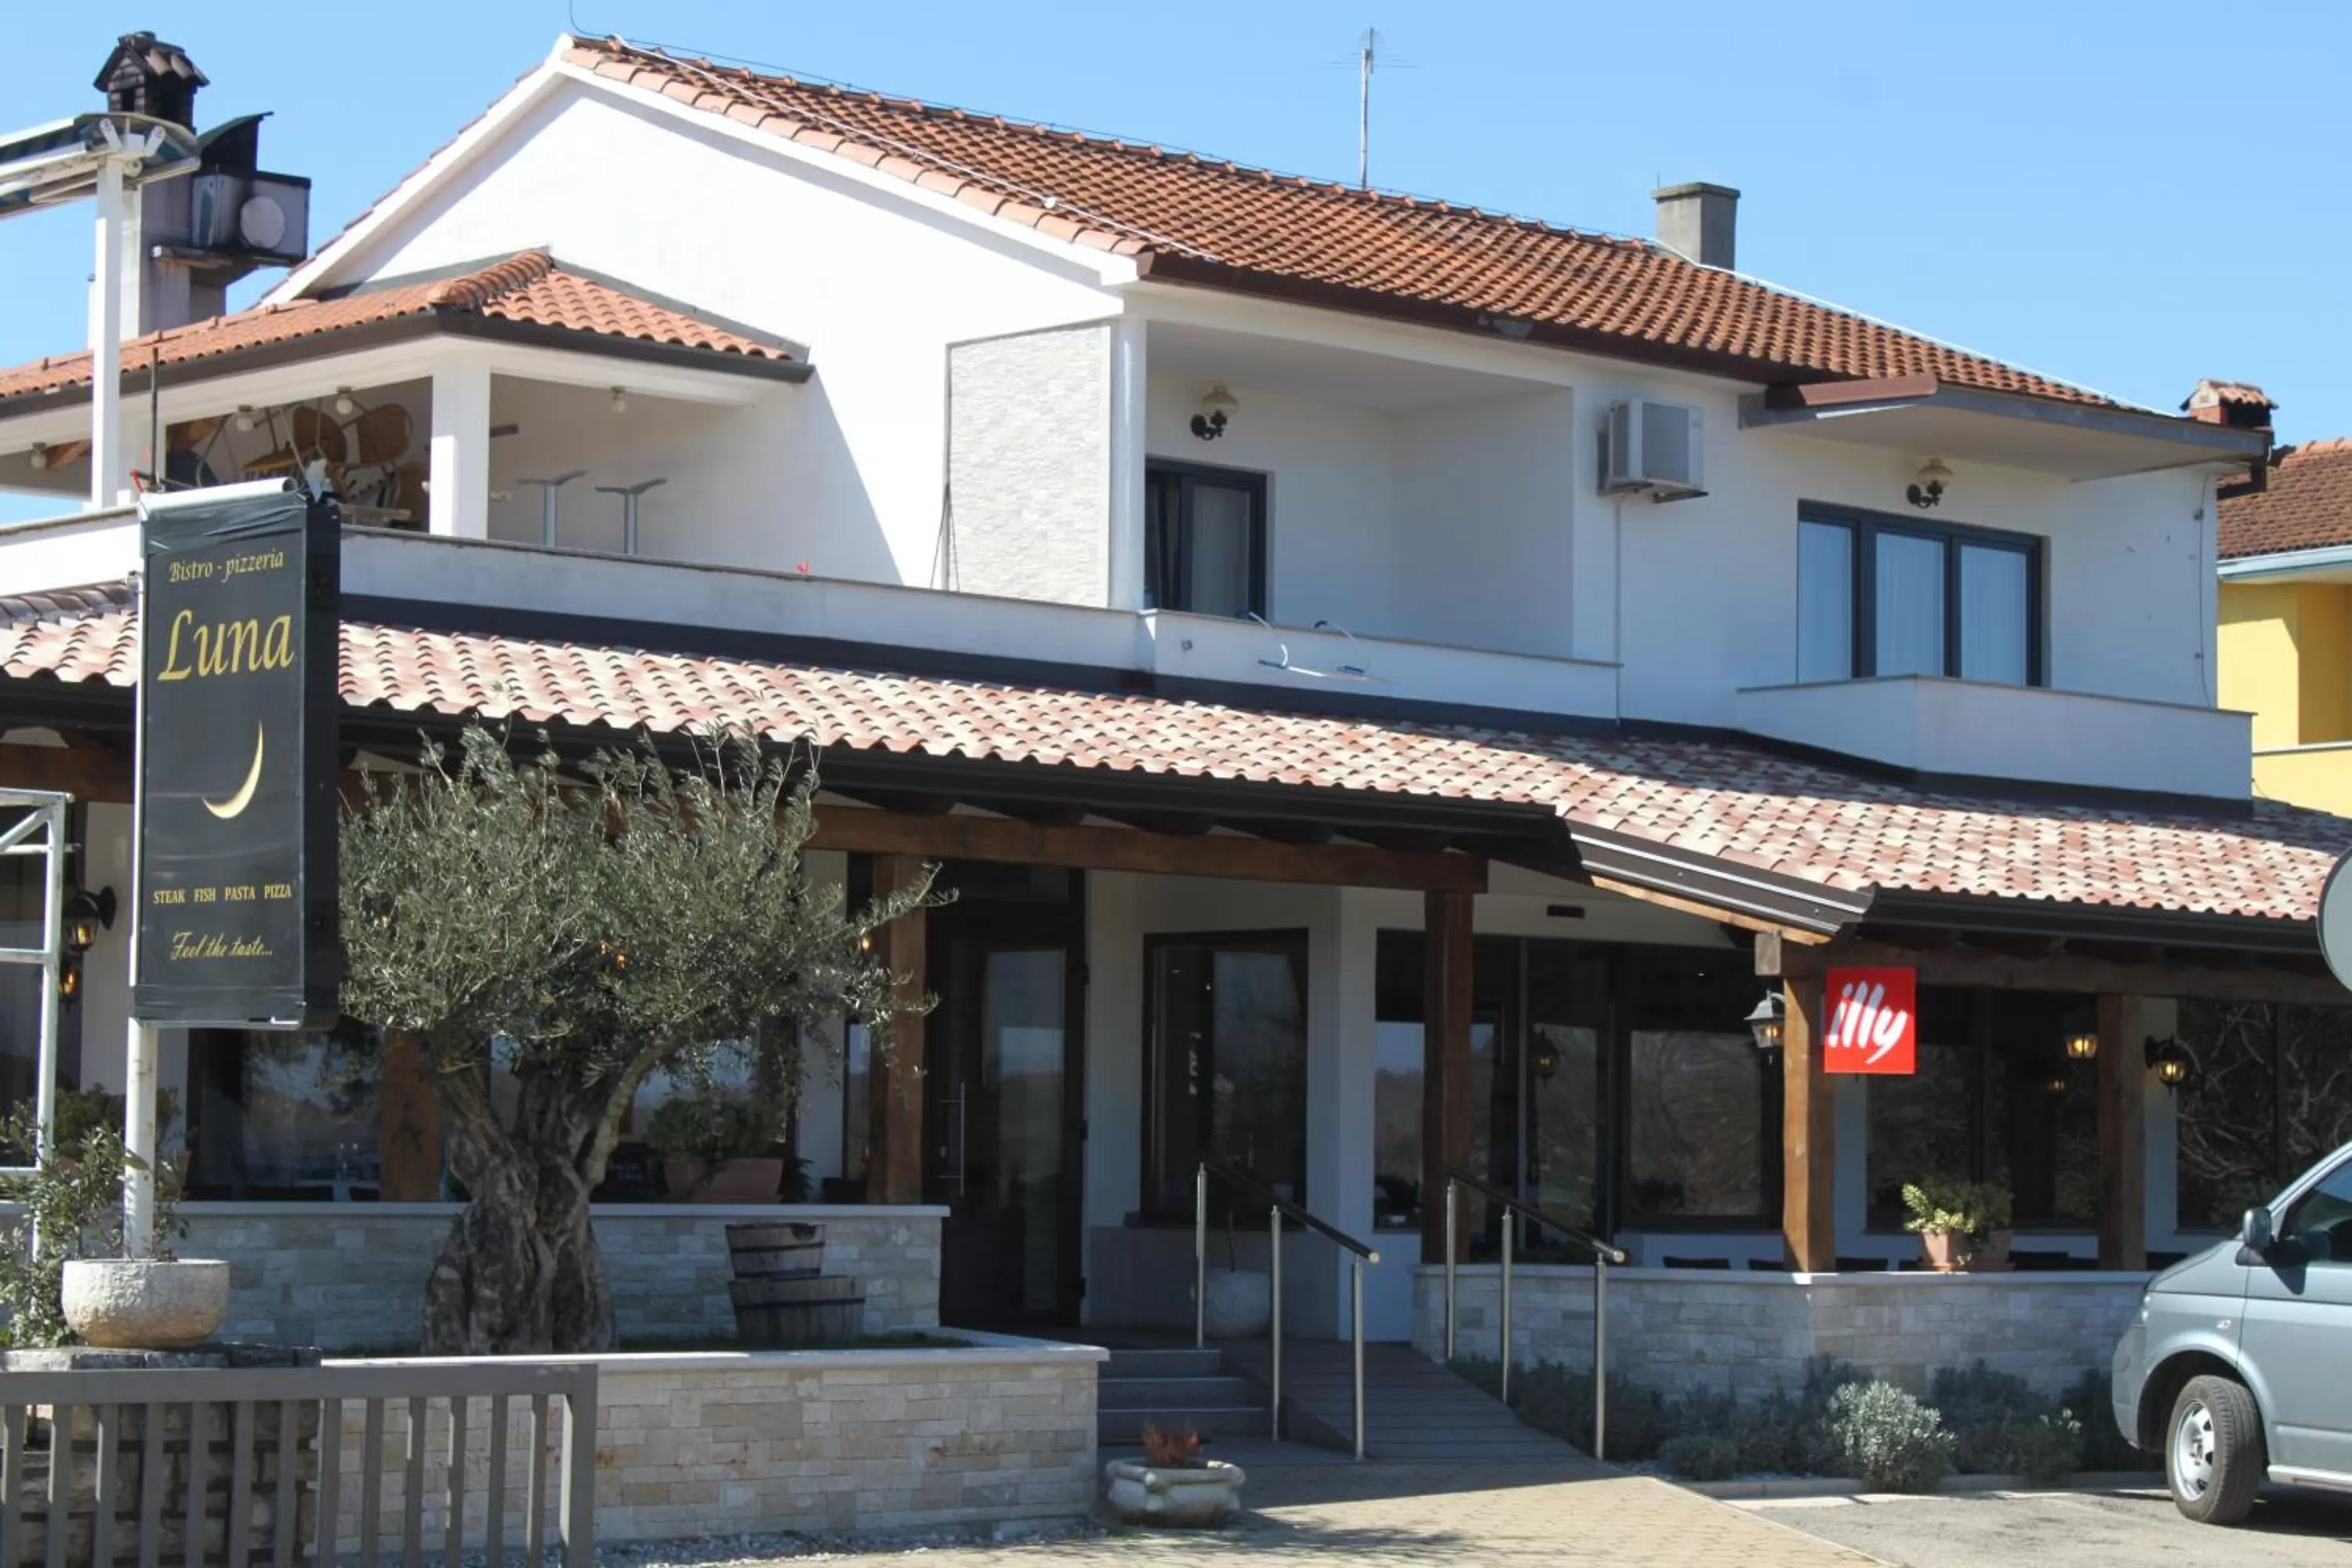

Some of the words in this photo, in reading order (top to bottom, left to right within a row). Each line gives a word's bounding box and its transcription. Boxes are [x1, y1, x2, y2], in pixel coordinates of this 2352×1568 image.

[169, 560, 213, 583] Bistro
[221, 550, 284, 583] pizzeria
[157, 609, 295, 681] Luna
[153, 889, 186, 904] STEAK
[194, 887, 216, 902] FISH
[224, 886, 256, 901] PASTA
[264, 884, 292, 899] PIZZA
[170, 931, 208, 960] Feel
[204, 932, 227, 957] the
[1828, 980, 1907, 1065] illy
